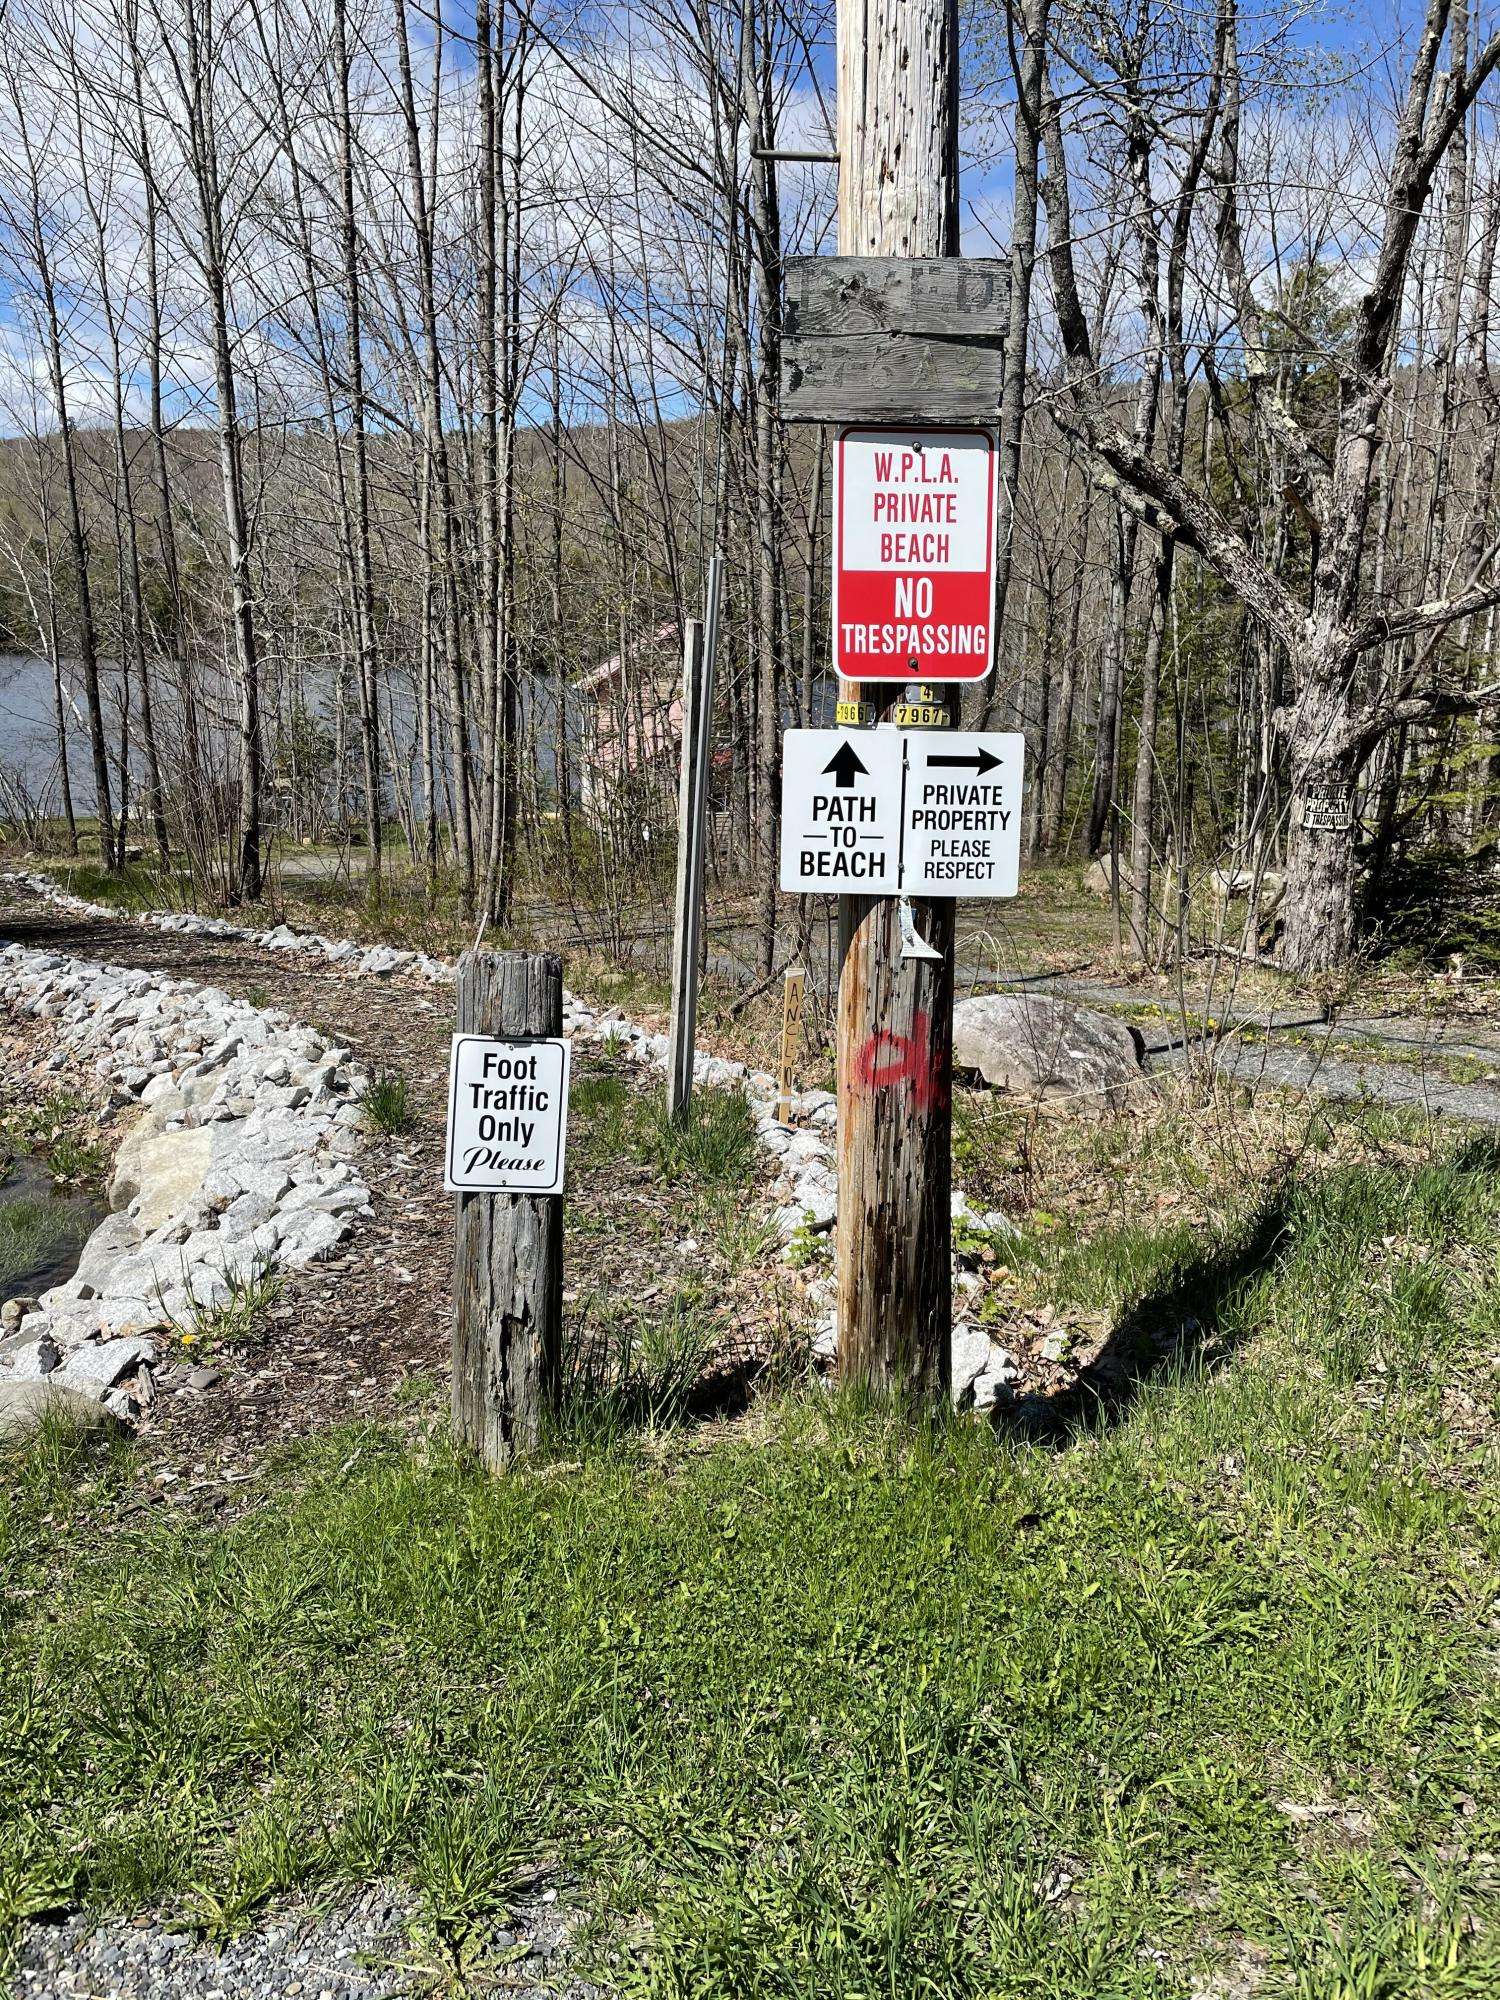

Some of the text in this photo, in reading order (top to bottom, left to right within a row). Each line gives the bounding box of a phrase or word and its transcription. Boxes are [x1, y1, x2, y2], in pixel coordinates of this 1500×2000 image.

[874, 452, 959, 483] W.P.L.A.
[874, 493, 957, 523] PRIVATE
[880, 533, 950, 563] BEACH
[894, 577, 933, 618] NO
[841, 623, 986, 655] TRESPASSING
[899, 708, 940, 723] 7967
[812, 795, 876, 822] PATH
[923, 784, 1003, 806] PRIVATE
[912, 810, 1012, 831] PROPERTY
[830, 826, 857, 848] TO
[930, 839, 991, 858] PLEASE
[800, 850, 886, 878] BEACH
[924, 861, 996, 880] RESPECT
[482, 1052, 537, 1080] Foot
[469, 1082, 549, 1112] Traffic
[478, 1114, 535, 1148] Only
[463, 1146, 546, 1175] Please
